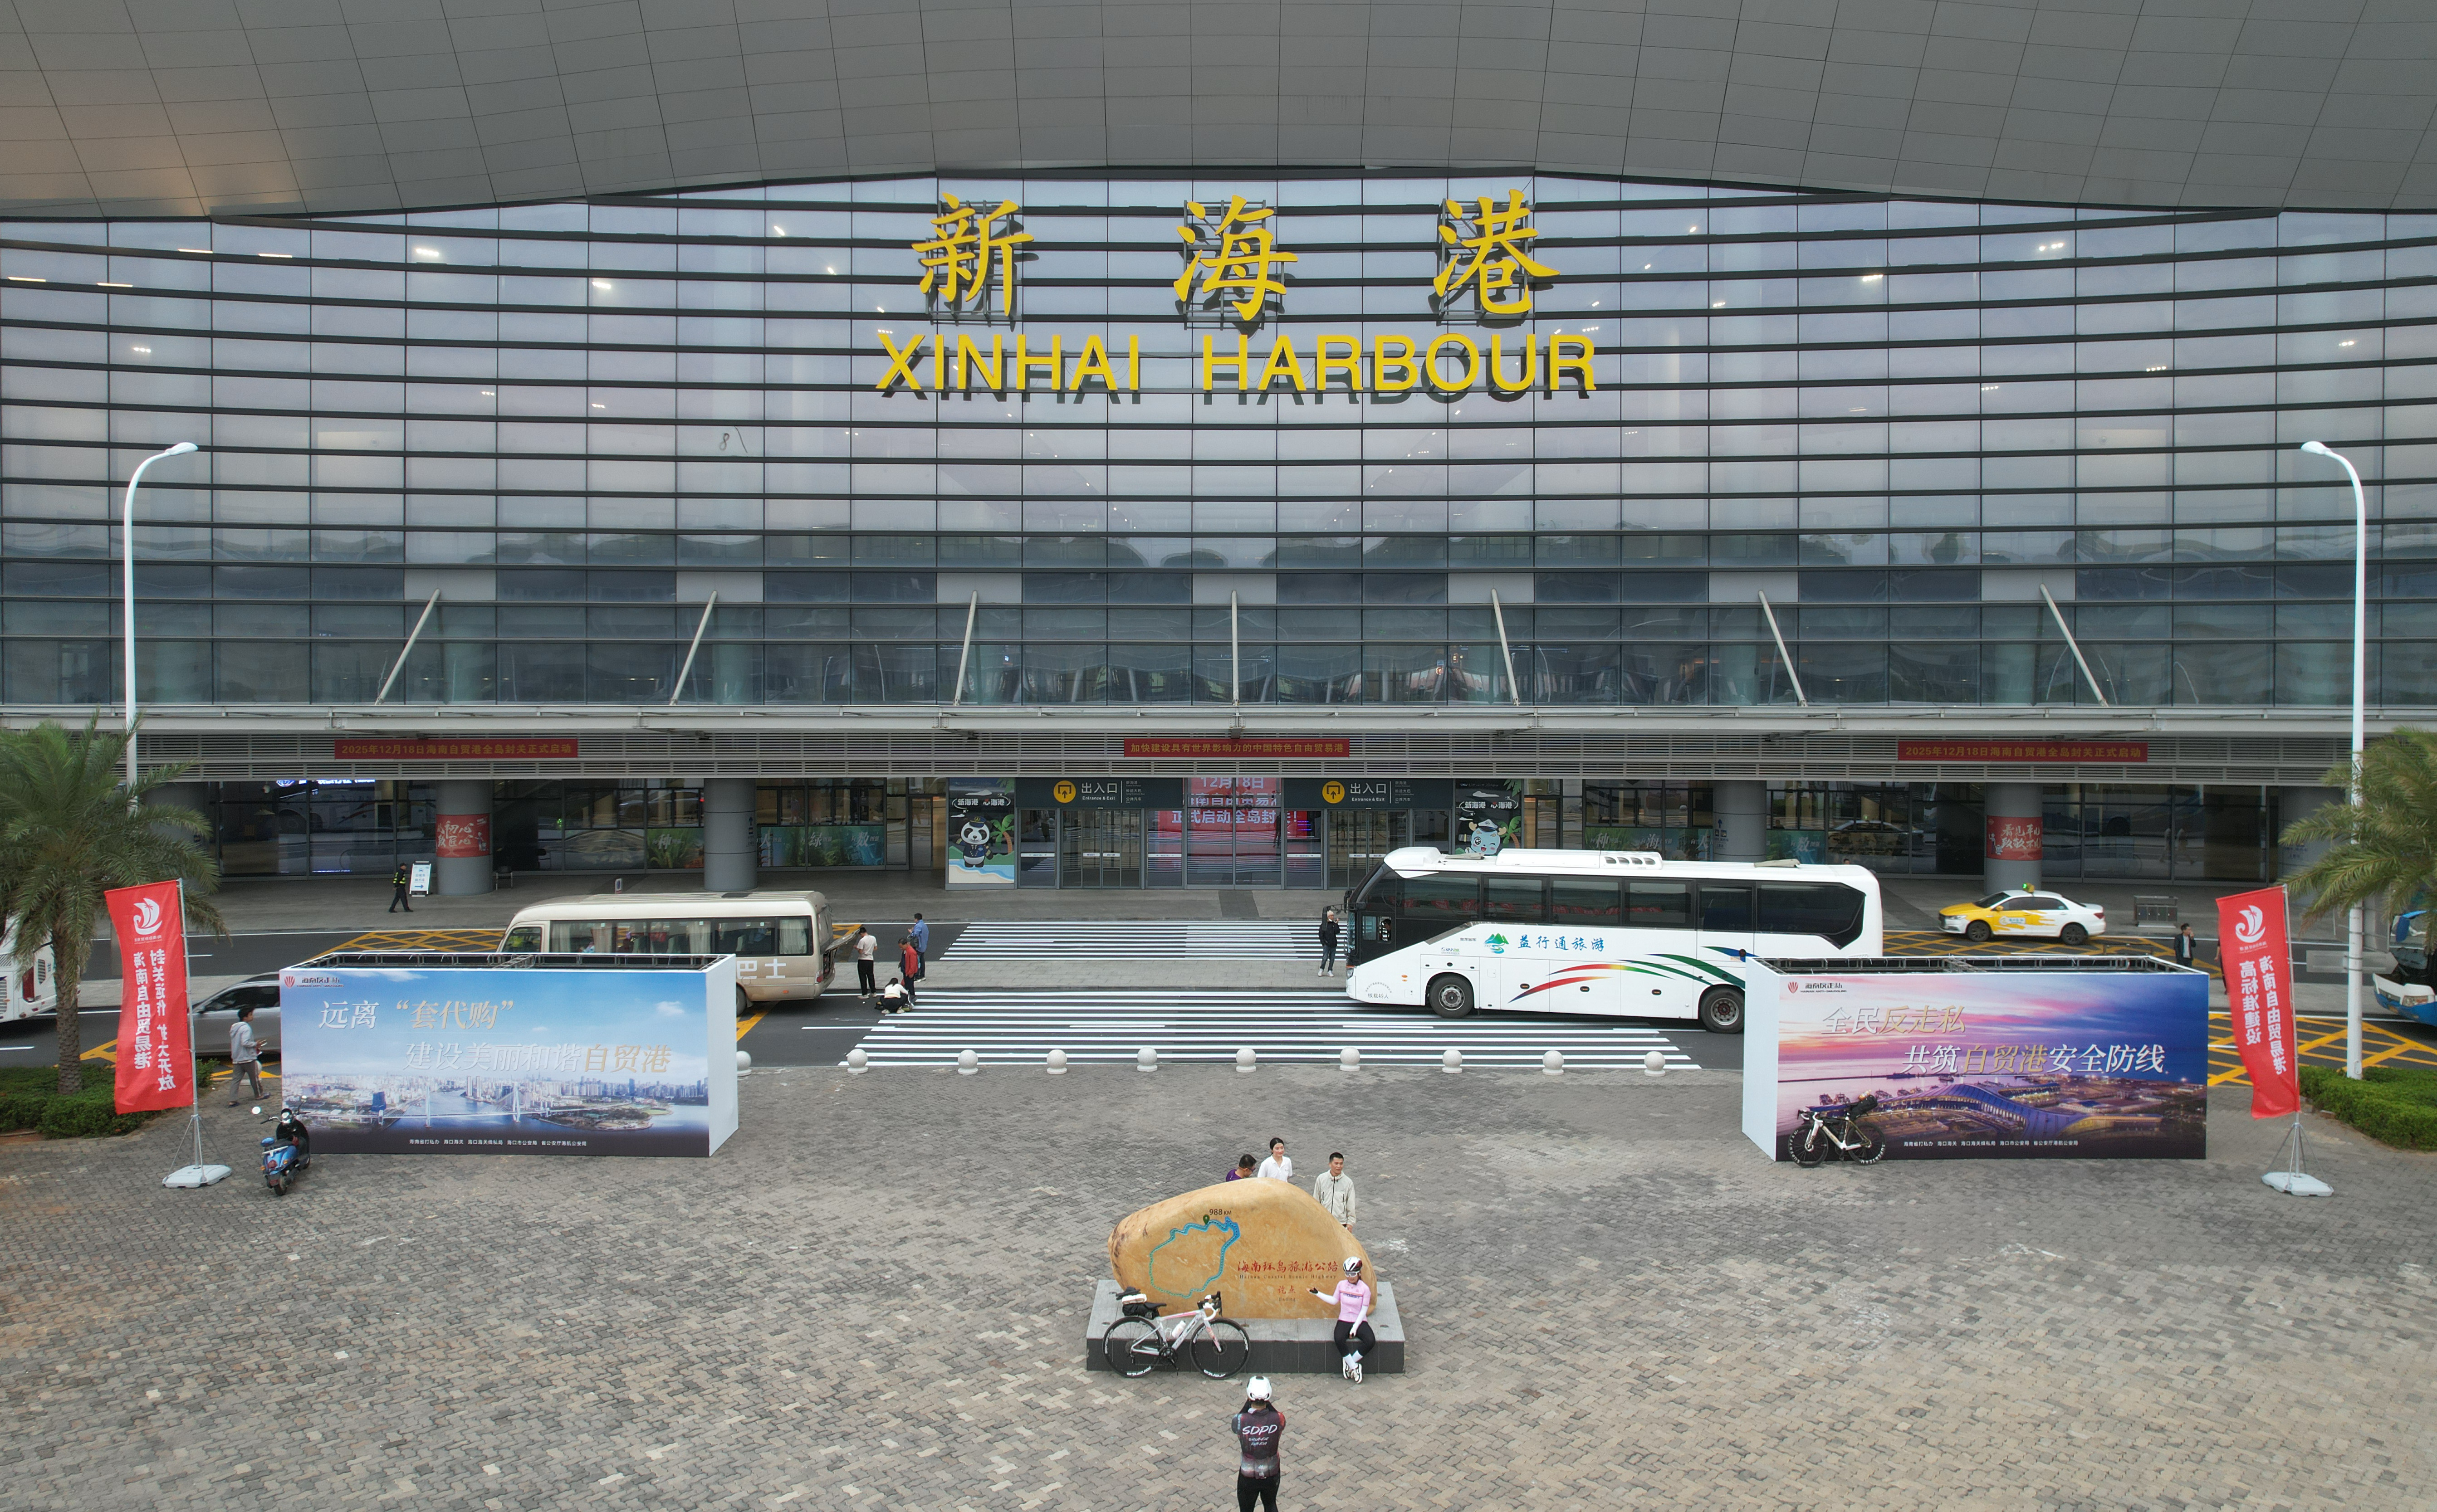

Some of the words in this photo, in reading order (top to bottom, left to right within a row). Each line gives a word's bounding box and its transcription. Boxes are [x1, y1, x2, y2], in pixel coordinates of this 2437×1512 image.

[911, 189, 1561, 321] 新海港
[876, 333, 1140, 391] XINHAI
[1202, 333, 1597, 392] HARBOUR
[1130, 743, 1344, 753] 加快建设具有世界影响力的中国特色自由贸易港
[1081, 782, 1117, 794] 出入口
[1350, 782, 1386, 794] 出入口
[1517, 934, 1604, 952] 益行通旅游
[737, 959, 786, 979] 巴士
[318, 1001, 380, 1029] 远离
[396, 1000, 514, 1030] “套代购”
[1821, 1005, 1966, 1034] 全民反走私
[402, 1042, 671, 1074] 建设美丽和谐自贸港
[1901, 1044, 2166, 1074] 共筑自贸港安全防线
[1238, 1260, 1339, 1273] 海南环岛旅游公路
[1242, 1424, 1278, 1435] SDPD
